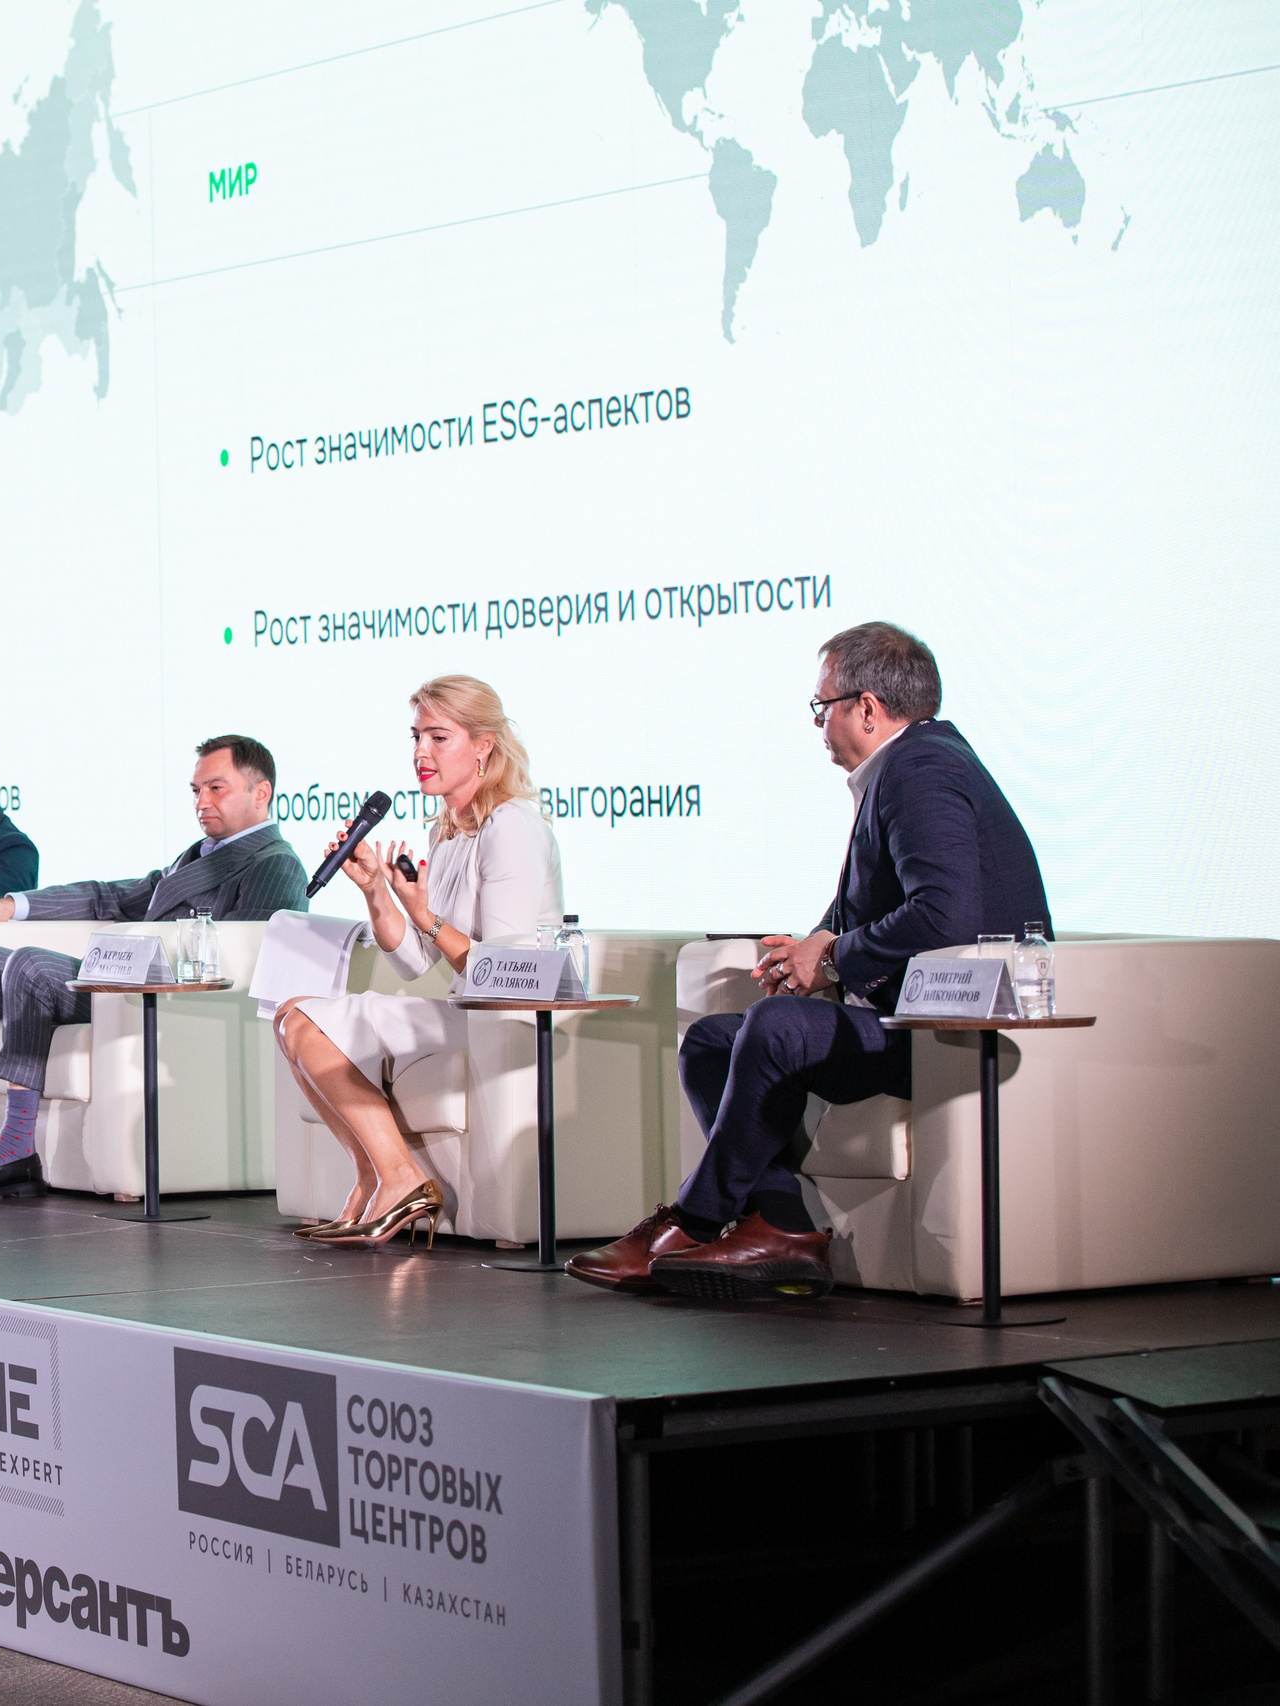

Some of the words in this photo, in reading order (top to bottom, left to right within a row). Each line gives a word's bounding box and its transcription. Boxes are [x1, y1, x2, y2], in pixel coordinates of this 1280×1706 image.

[208, 161, 258, 203] МИР
[250, 432, 308, 474] Рост
[314, 410, 473, 466] значимости
[482, 385, 691, 444] ESG-аспектов
[253, 608, 312, 648] Рост
[318, 599, 478, 644] значимости
[485, 587, 609, 640] доверия
[618, 588, 637, 622] и
[645, 573, 831, 628] открытости
[540, 784, 701, 828] выгорания
[489, 976, 539, 990] ДОЛЯКОВА
[496, 960, 537, 973] ТАТЬЯНА
[926, 970, 973, 984] ДМИТРИЙ
[922, 989, 980, 1002] НИКОНОРОВ
[346, 1394, 434, 1447] СОЮЗ
[188, 1384, 328, 1512] SCA
[347, 1446, 503, 1515] ТОРГОВЫХ
[349, 1498, 487, 1564] ЦЕНТРОВ
[188, 1531, 254, 1565] РОССИЯ
[286, 1555, 369, 1594] БЕЛАРУСЬ
[402, 1583, 507, 1627] КАЗАХСТАН
